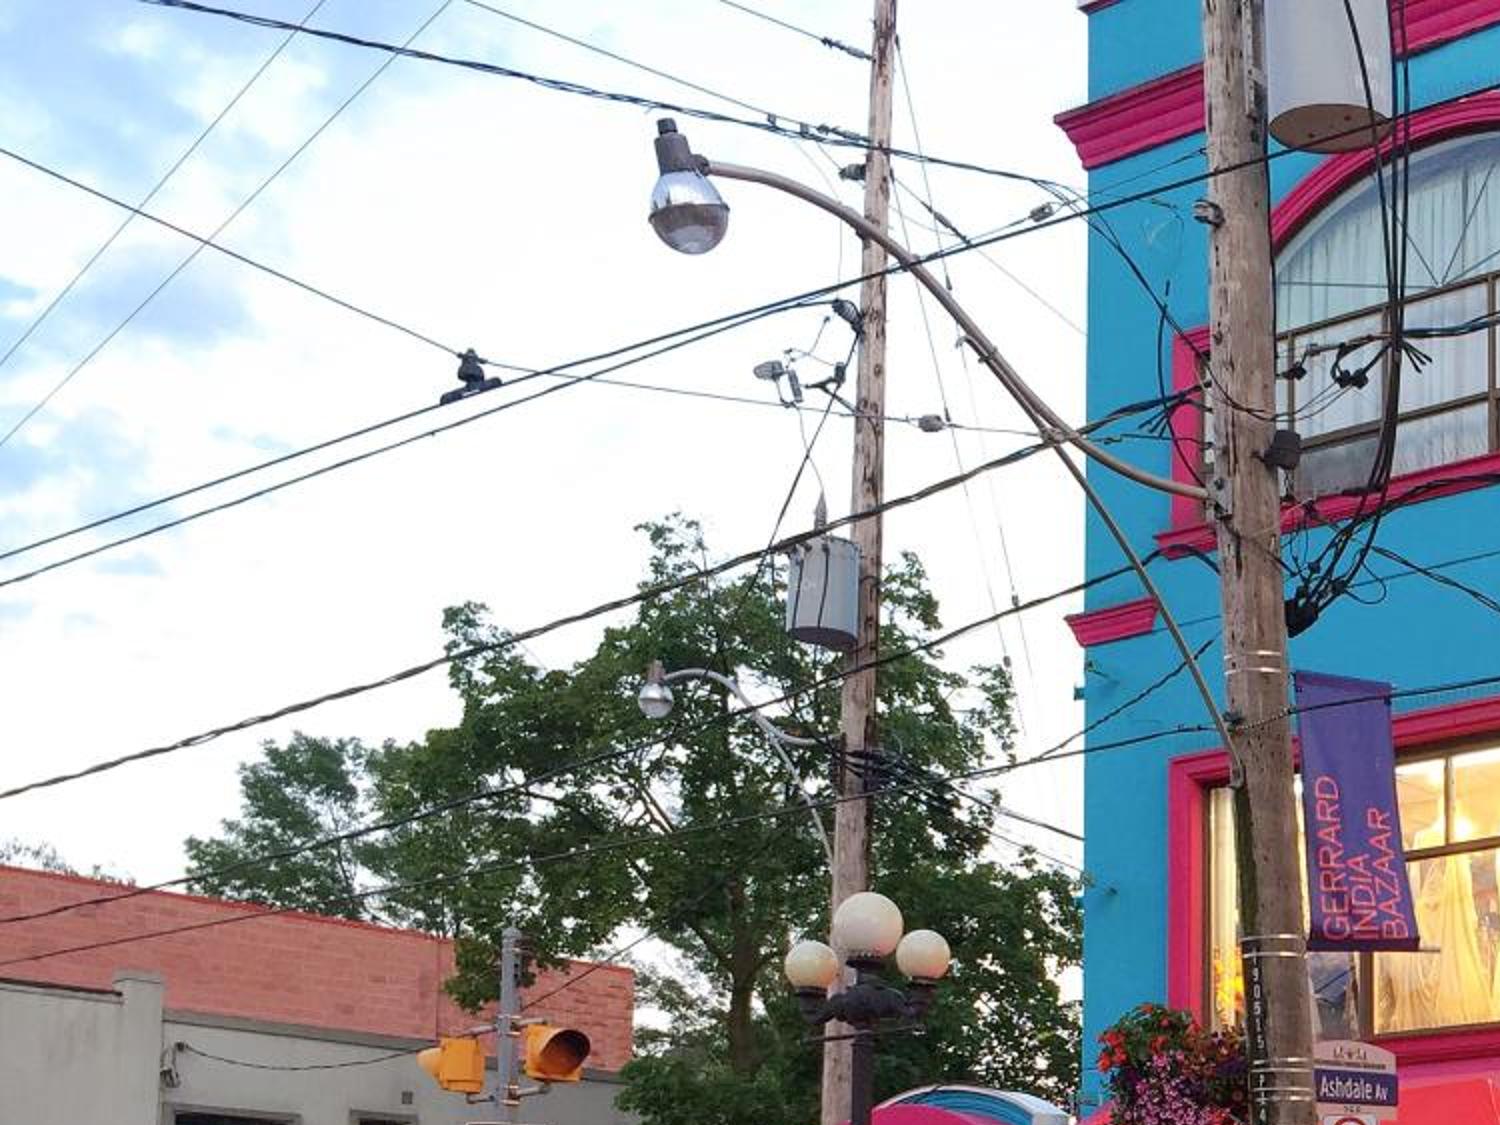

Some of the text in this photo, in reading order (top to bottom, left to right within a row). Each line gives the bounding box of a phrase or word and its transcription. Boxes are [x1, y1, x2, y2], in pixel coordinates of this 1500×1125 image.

[1315, 775, 1351, 941] GERRARD
[1346, 853, 1380, 940] INDIA
[1367, 807, 1409, 939] BAZAAR
[1319, 1075, 1373, 1100] Ashdale
